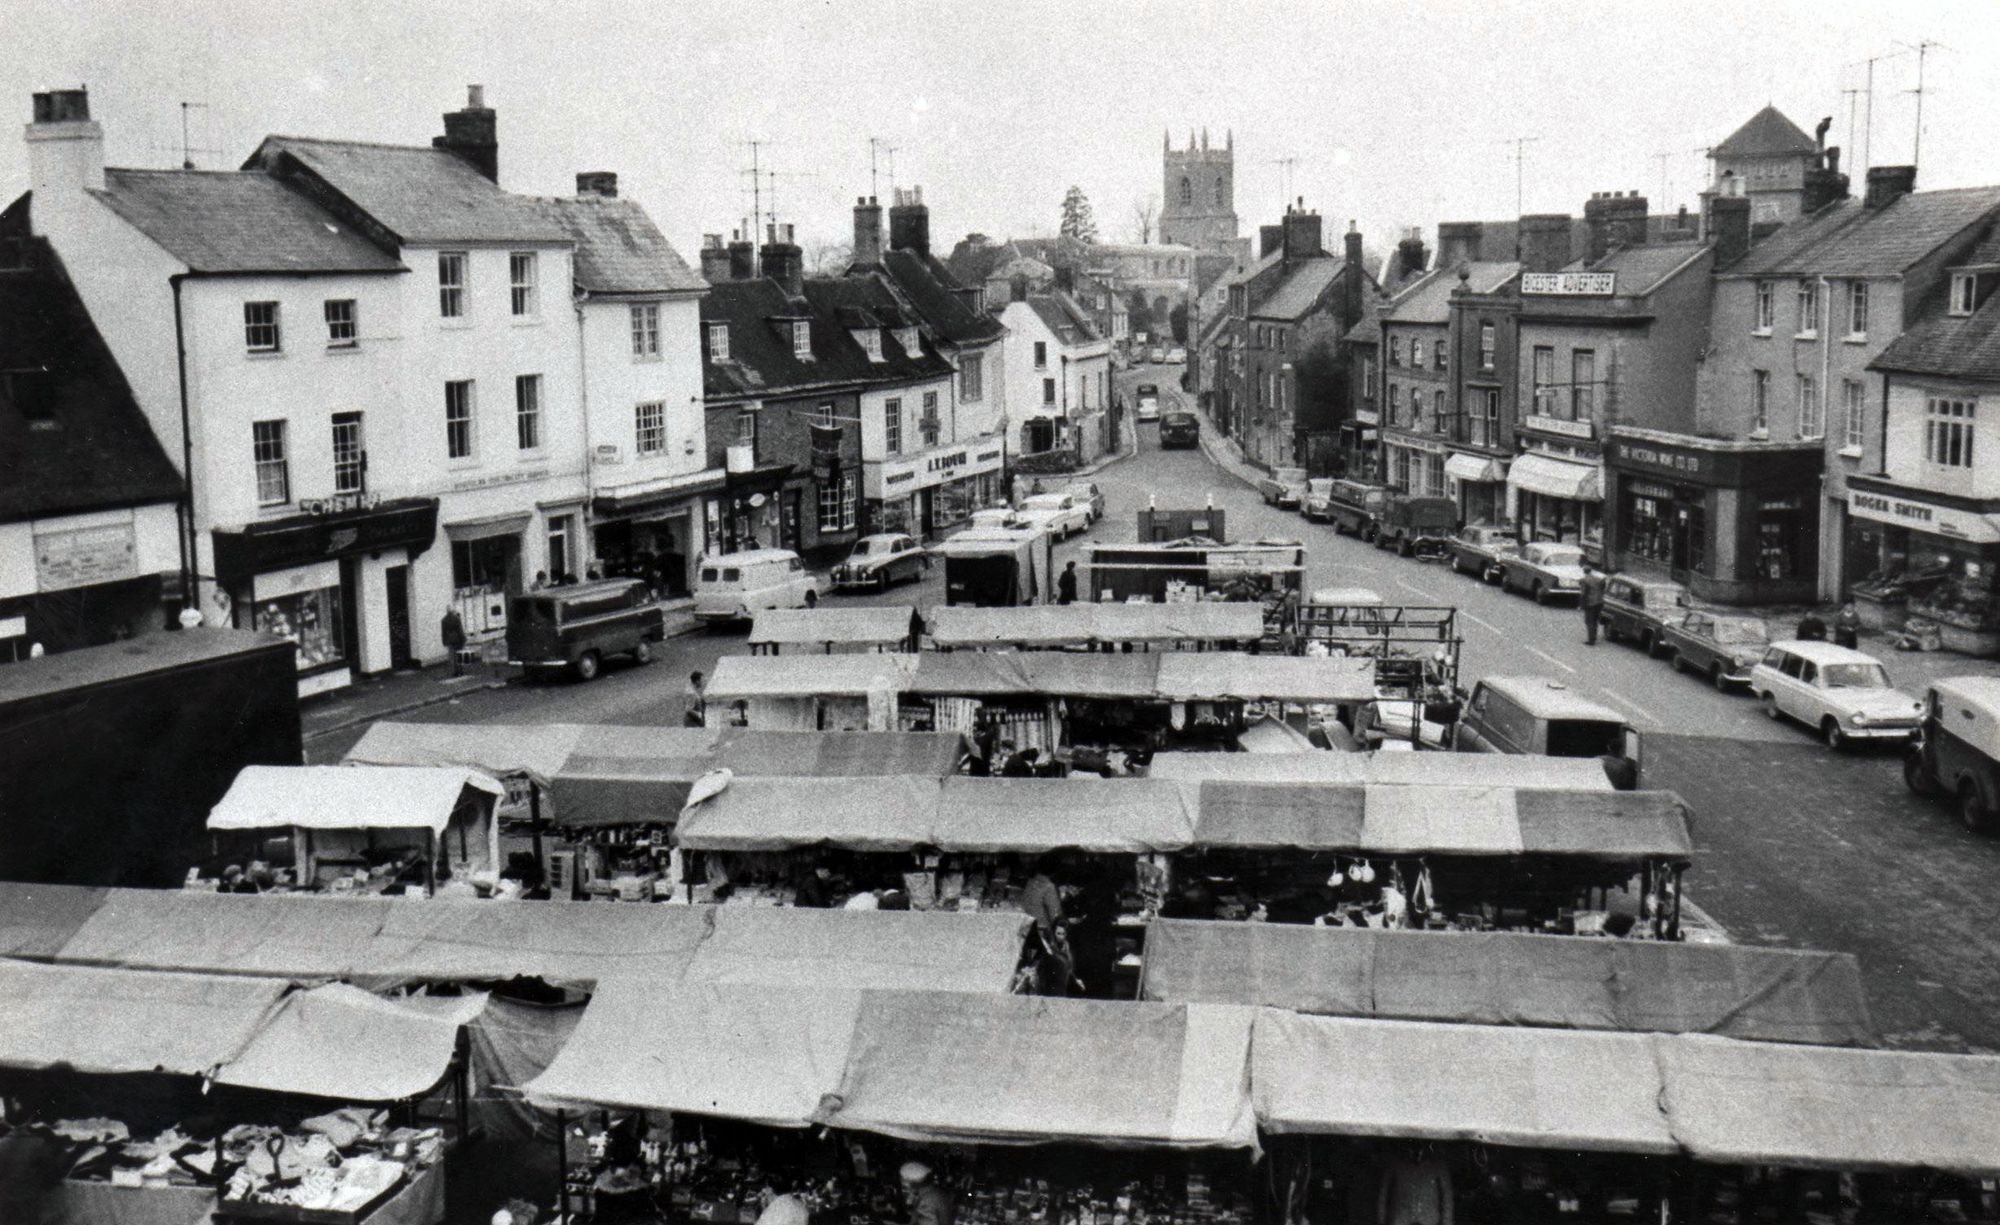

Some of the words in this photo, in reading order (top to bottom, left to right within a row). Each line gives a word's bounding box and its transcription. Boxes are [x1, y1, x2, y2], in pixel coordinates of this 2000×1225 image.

[1523, 274, 1561, 291] BICESTER
[1563, 274, 1613, 293] ADVERTISER
[1631, 448, 1657, 463] VICTORIA
[1660, 452, 1674, 468] WINE
[1854, 494, 1889, 512] ROGER
[1895, 502, 1932, 521] SMITH
